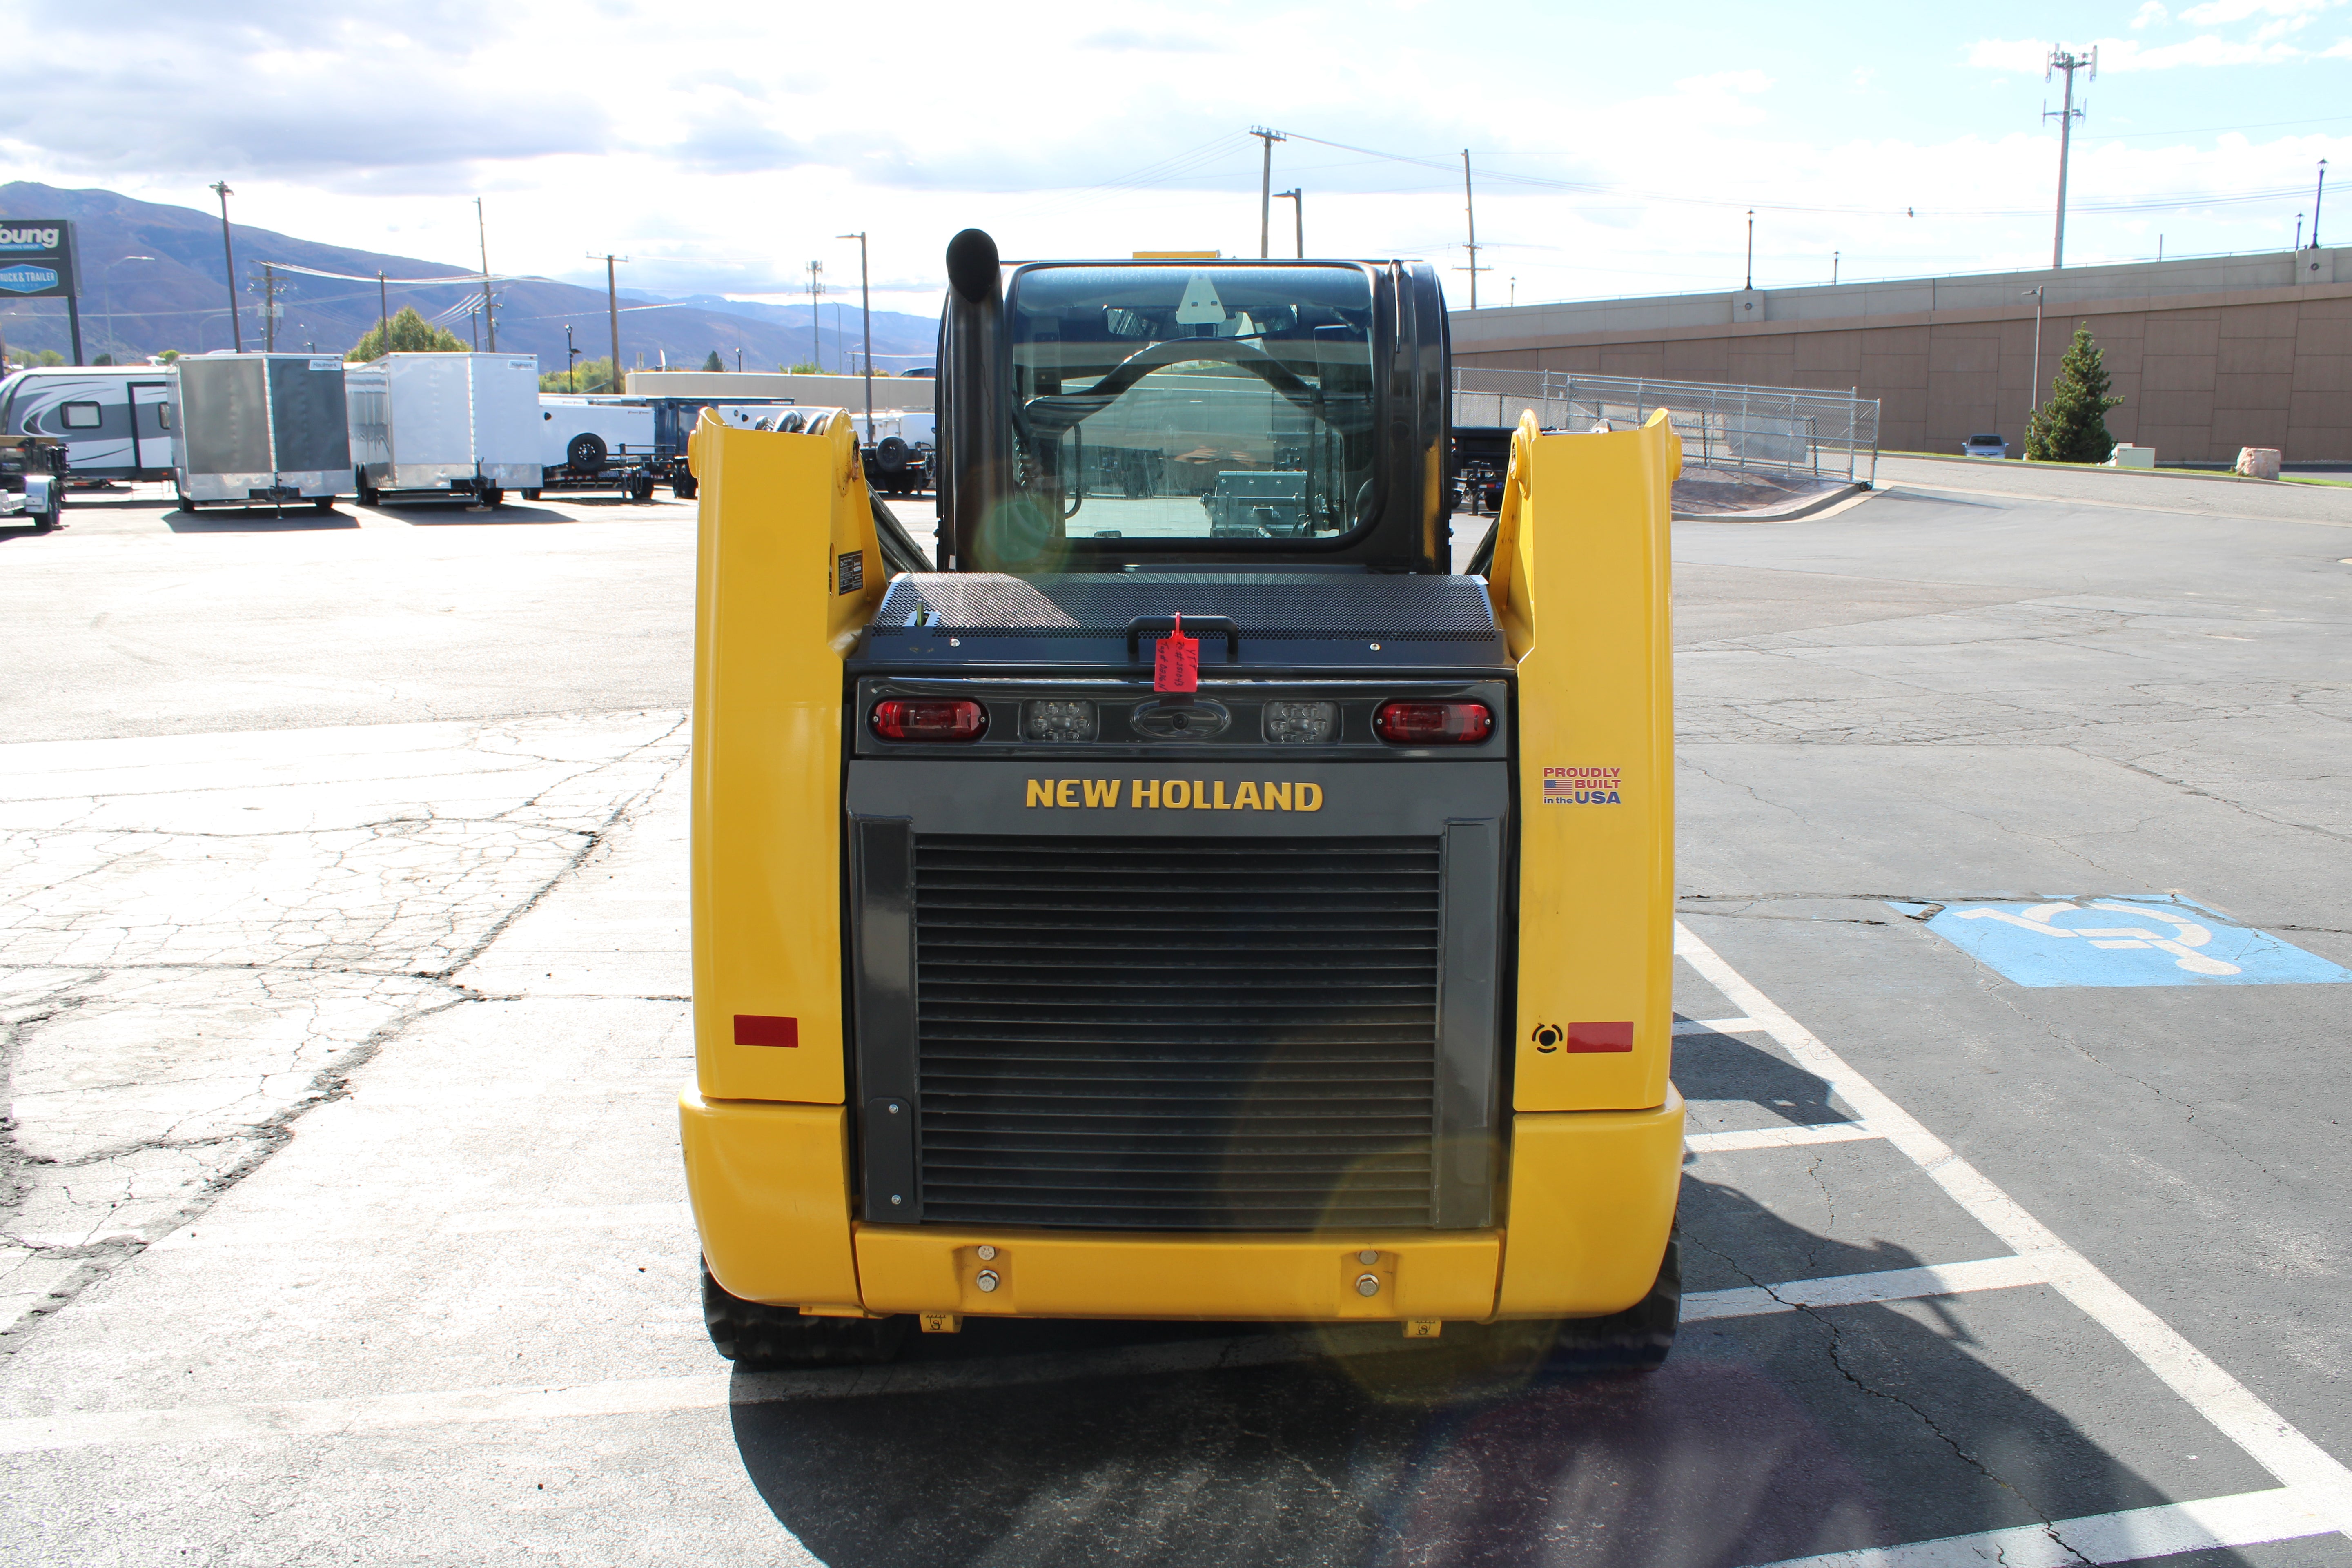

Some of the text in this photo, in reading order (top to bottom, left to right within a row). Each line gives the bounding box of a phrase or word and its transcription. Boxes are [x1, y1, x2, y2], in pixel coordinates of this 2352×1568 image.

[0, 224, 59, 248] oung
[0, 272, 55, 282] RUCK & TRAILER
[1543, 768, 1621, 777] PROUDLY
[1575, 779, 1621, 789] BUILT
[1026, 779, 1323, 811] NEW HOLLAND
[1575, 791, 1621, 804] USA
